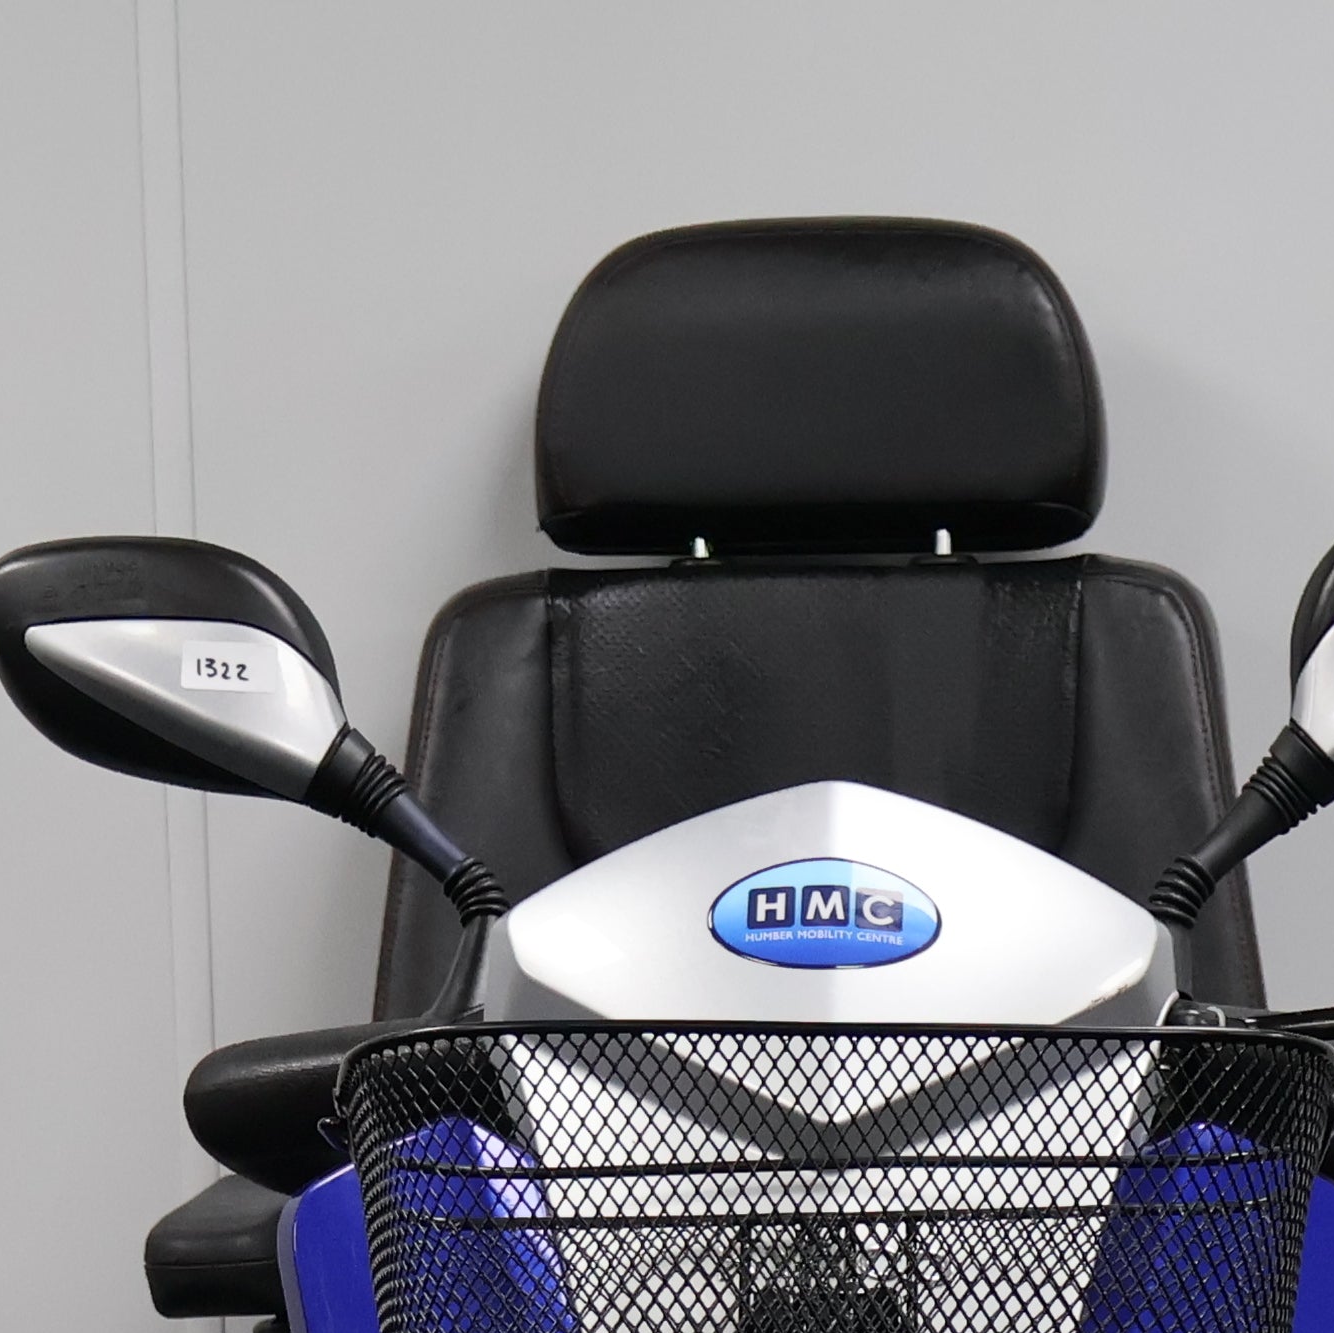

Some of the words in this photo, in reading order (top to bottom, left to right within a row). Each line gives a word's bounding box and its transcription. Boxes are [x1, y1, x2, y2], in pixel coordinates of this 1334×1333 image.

[196, 657, 250, 682] 1322
[753, 888, 898, 928] HMC
[744, 930, 794, 943] HUMBER
[797, 929, 854, 941] MOBILITY
[856, 931, 904, 946] CENTRE
